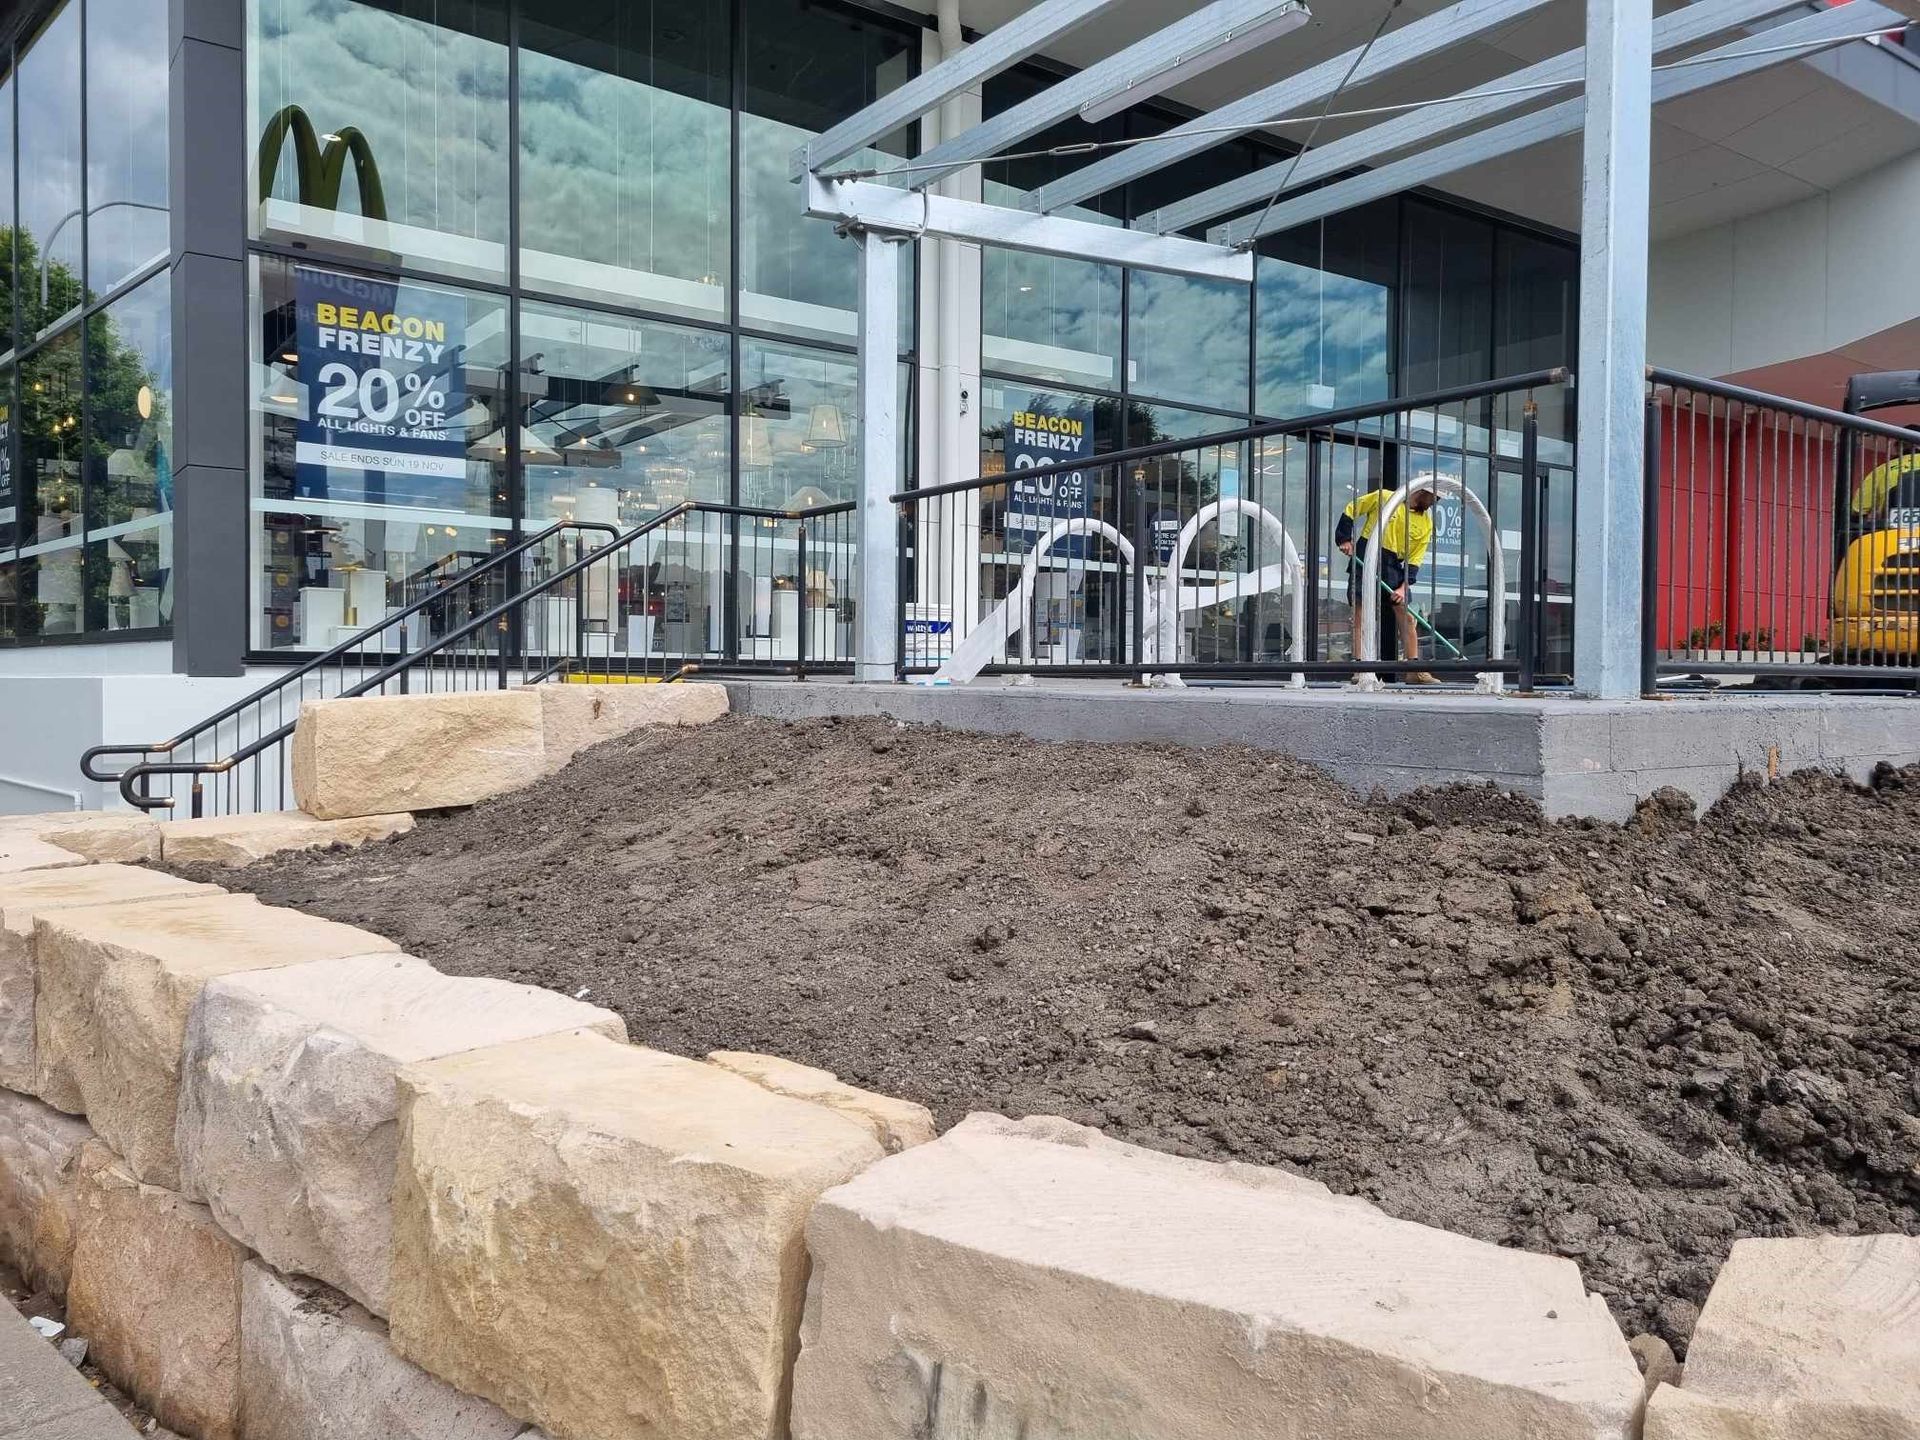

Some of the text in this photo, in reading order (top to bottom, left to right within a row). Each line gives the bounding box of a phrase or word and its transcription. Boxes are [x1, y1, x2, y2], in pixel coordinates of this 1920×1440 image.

[317, 303, 444, 342] BEACON
[318, 327, 444, 364] FRENZY
[317, 418, 342, 429] ALL
[347, 421, 395, 435] LIGHTS
[400, 427, 408, 437] &
[405, 409, 445, 427] OFF
[1013, 411, 1082, 435] BEACON
[1014, 431, 1082, 453] FRENZY
[320, 450, 444, 471] SALE ENDS SUN 19 NOV
